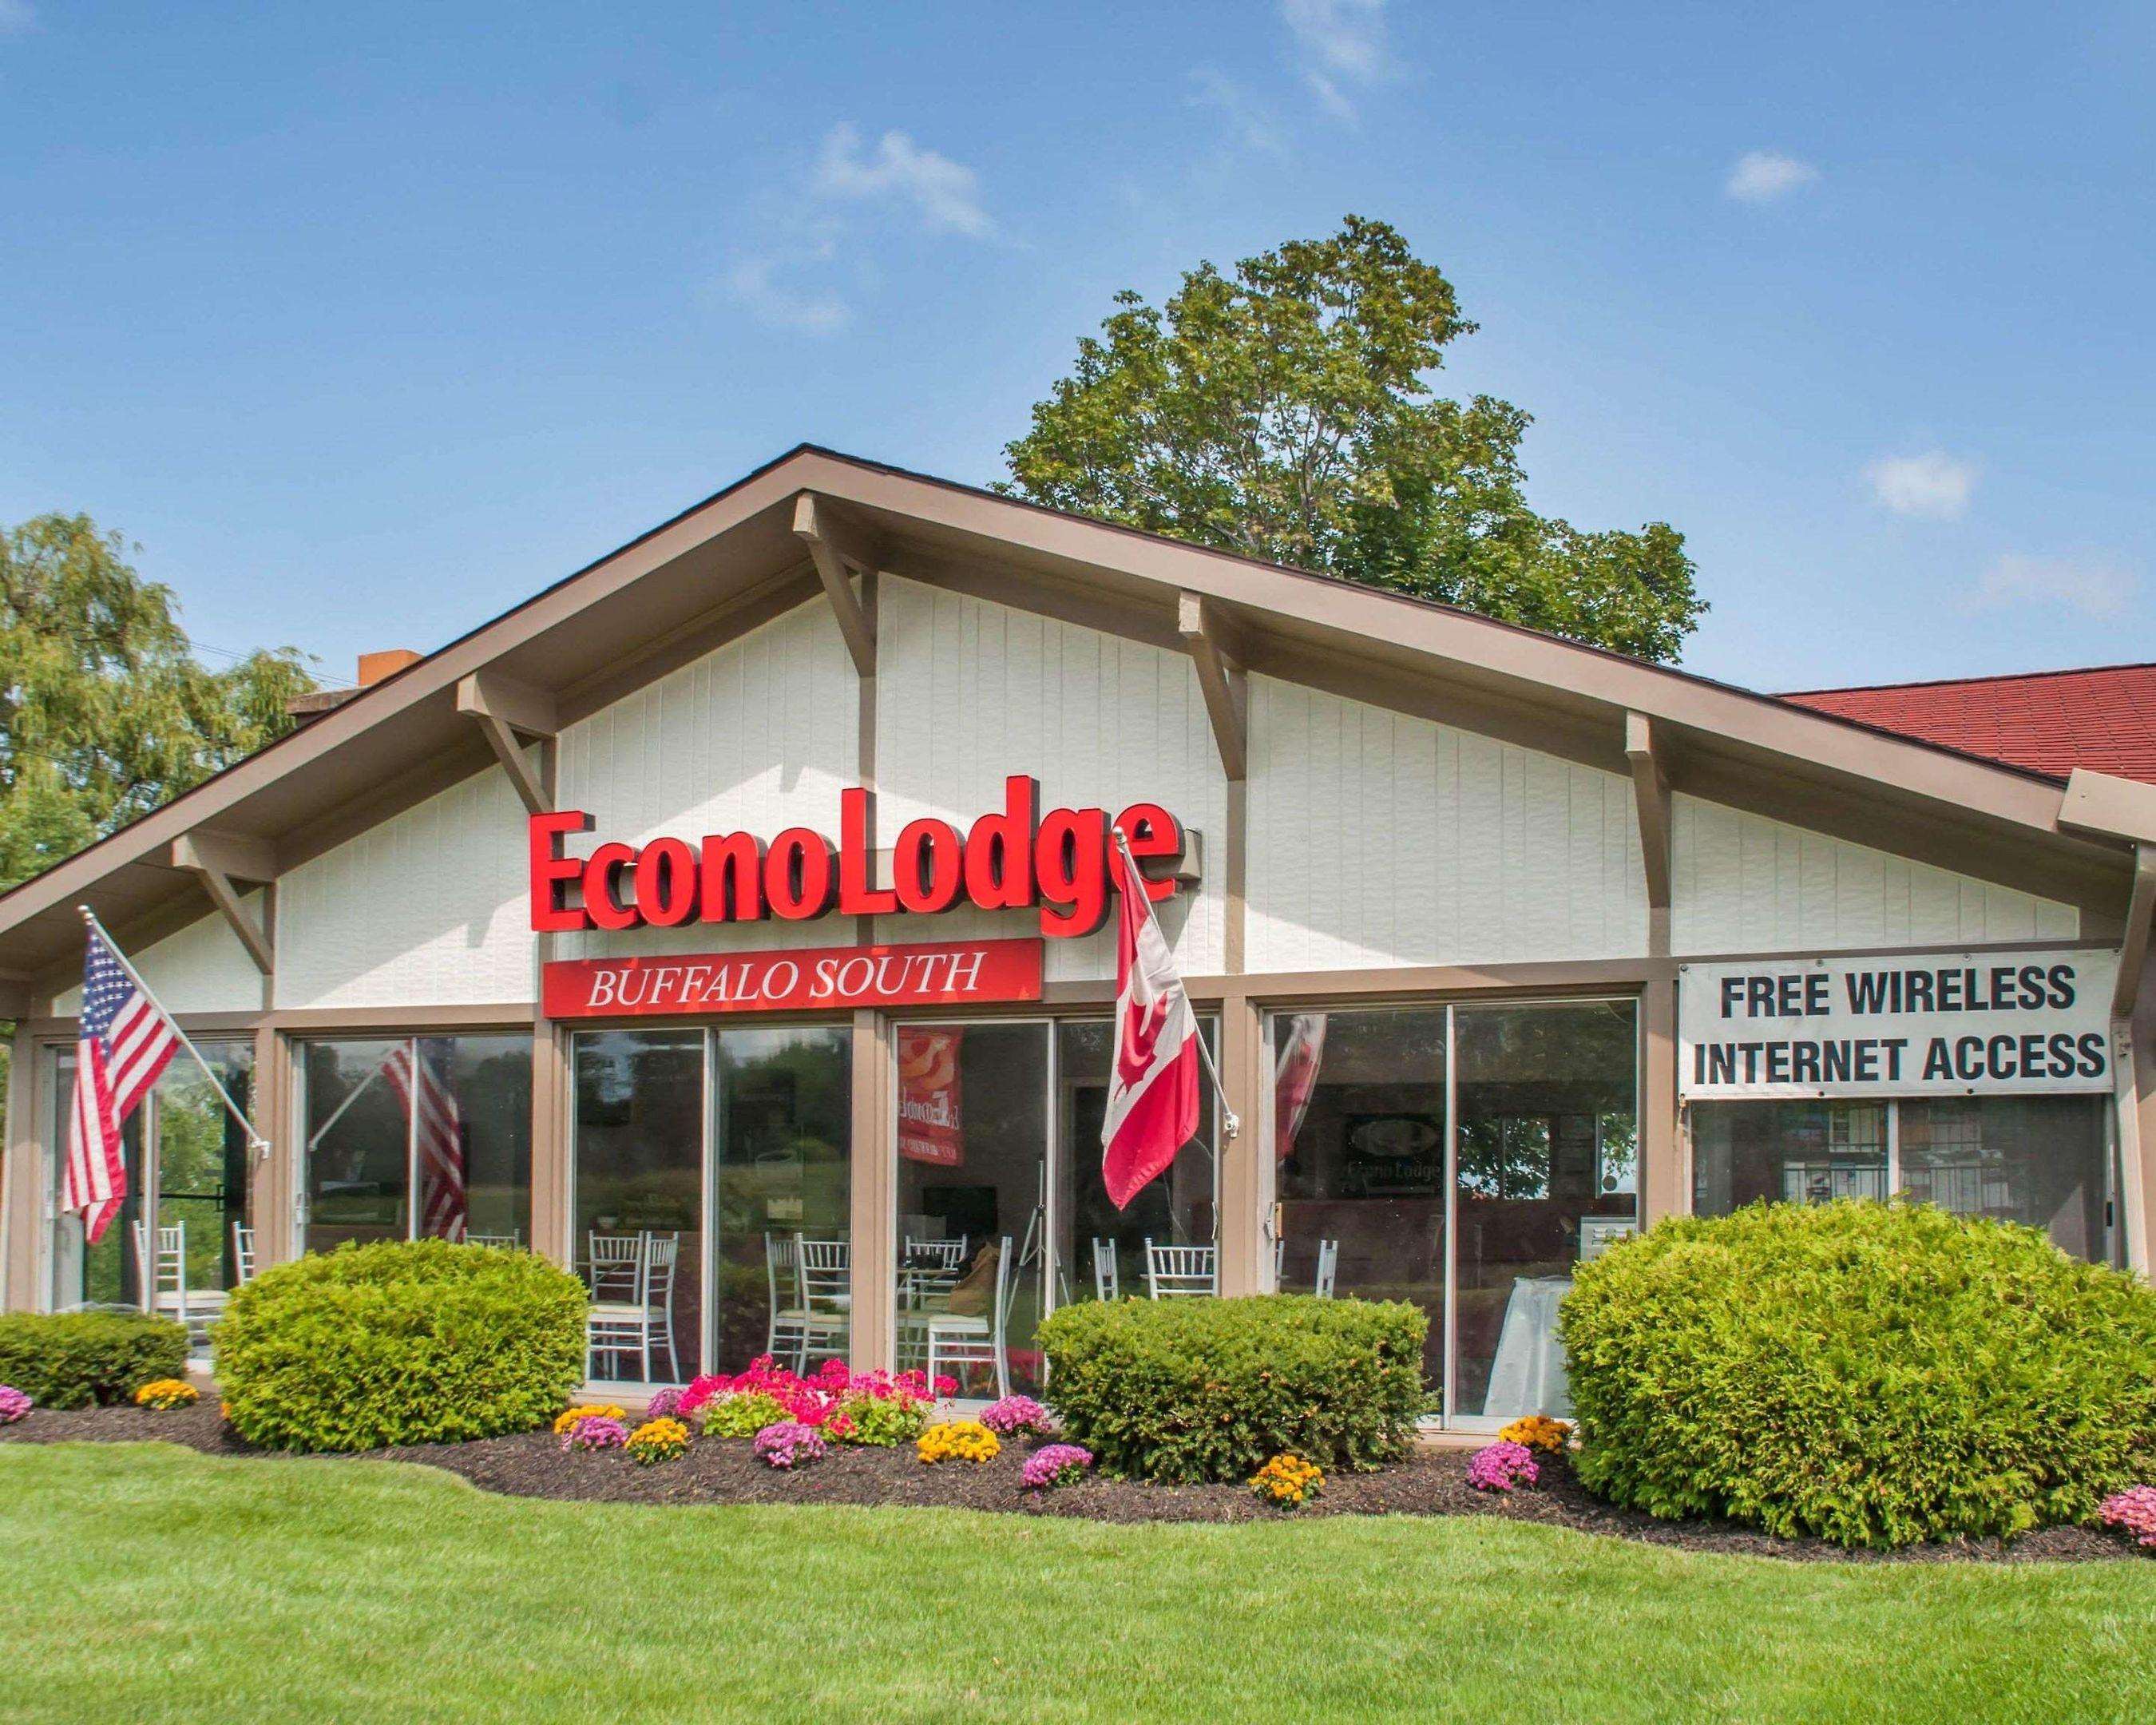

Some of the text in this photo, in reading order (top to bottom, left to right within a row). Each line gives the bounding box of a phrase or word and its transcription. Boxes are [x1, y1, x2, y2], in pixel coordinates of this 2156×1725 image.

[586, 951, 985, 1008] BUFFALO SOUTH
[1721, 964, 2076, 1019] FREE WIRELESS
[1694, 1033, 2106, 1085] INTERNET ACCESS
